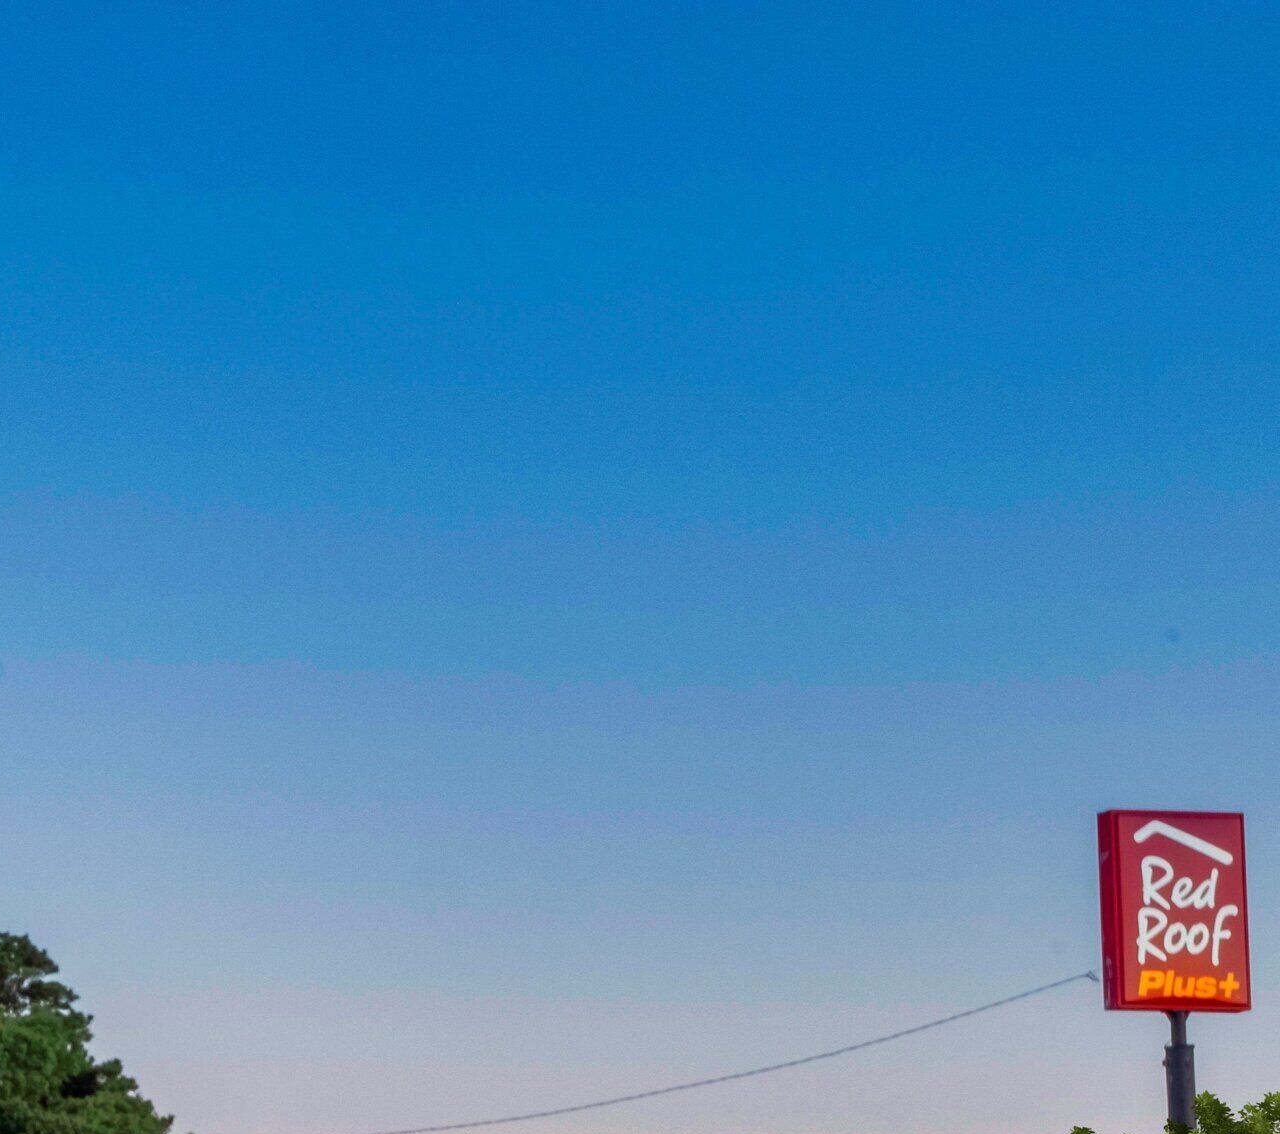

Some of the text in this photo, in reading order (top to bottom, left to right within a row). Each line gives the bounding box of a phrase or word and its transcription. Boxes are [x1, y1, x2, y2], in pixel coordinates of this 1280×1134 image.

[1141, 855, 1219, 910] Red
[1136, 904, 1238, 966] Roof
[1138, 969, 1239, 998] Plus+
